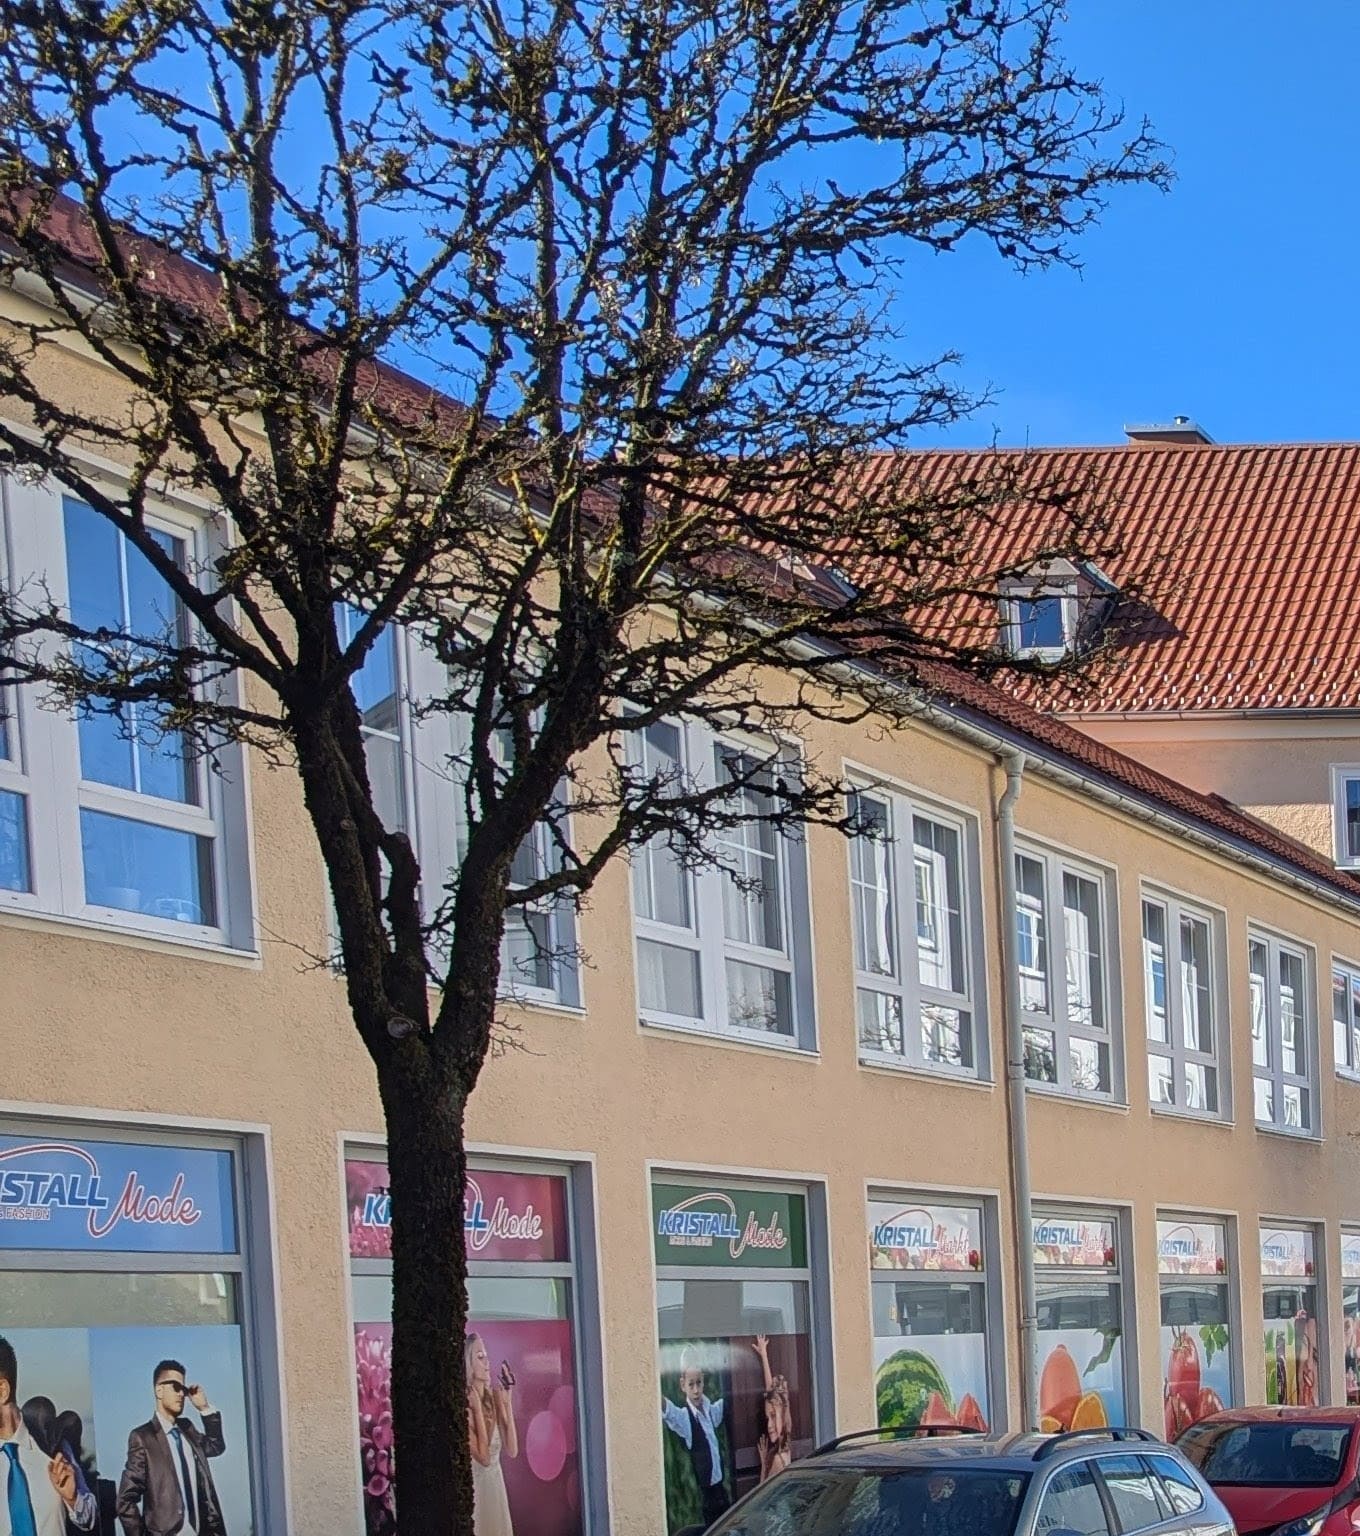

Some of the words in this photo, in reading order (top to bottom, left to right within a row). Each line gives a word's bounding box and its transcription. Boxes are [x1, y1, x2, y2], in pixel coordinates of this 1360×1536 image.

[0, 1170, 109, 1209] STALL
[104, 1170, 201, 1226] Mode
[483, 1197, 543, 1240] Mode
[658, 1210, 741, 1238] KRISTALL
[740, 1211, 787, 1249] Mode
[873, 1225, 938, 1248] KRISTALL
[1033, 1226, 1082, 1246] KRISTALL
